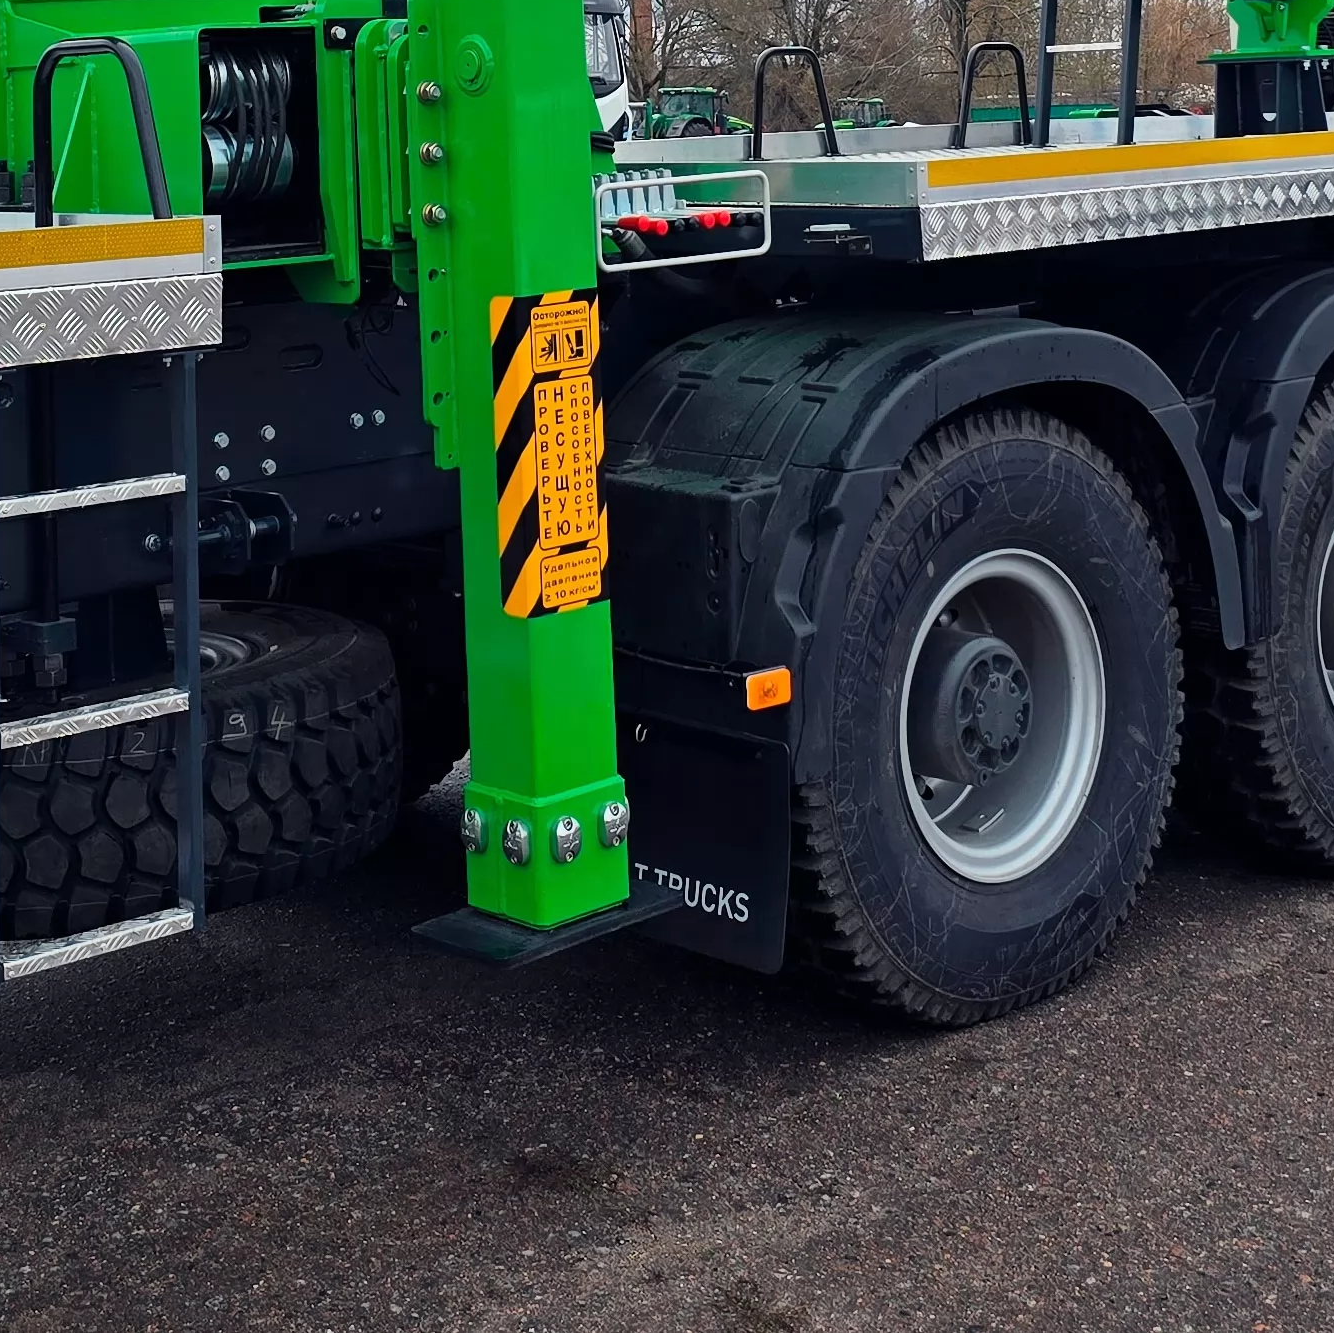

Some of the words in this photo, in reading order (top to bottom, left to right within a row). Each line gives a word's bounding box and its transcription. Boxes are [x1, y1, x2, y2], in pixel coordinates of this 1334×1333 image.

[532, 305, 587, 321] Осторожно!
[538, 389, 552, 540] ПРОВЕРЬТЕ
[553, 386, 571, 537] НЕСУЩУЮ
[569, 384, 583, 533] СПОСОБНОСТЬ
[581, 381, 595, 531] ПОВЕРХНОСТИ
[554, 589, 567, 600] 10
